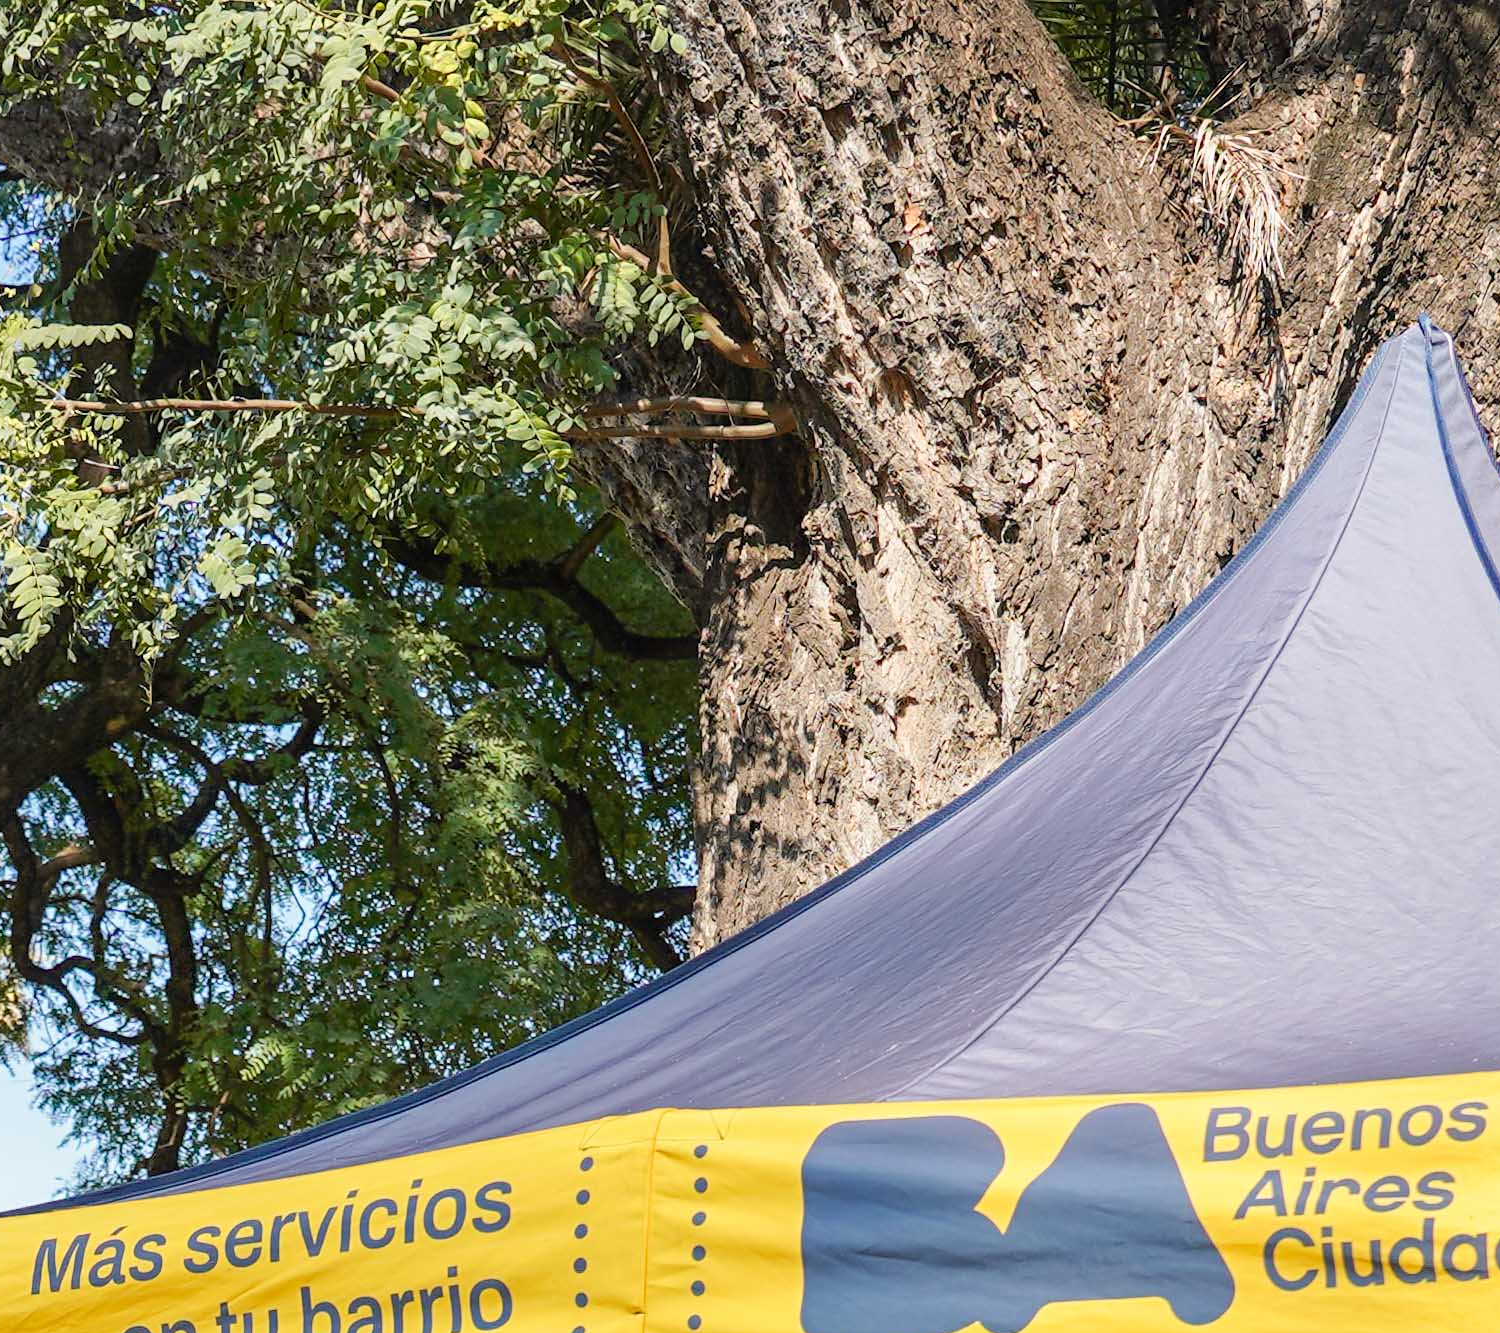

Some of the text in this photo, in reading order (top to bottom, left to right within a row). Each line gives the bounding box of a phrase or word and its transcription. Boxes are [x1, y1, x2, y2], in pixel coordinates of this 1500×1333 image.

[1202, 1101, 1489, 1163] Buenos
[1233, 1170, 1455, 1220] Aires
[31, 1179, 511, 1295] Más servicios
